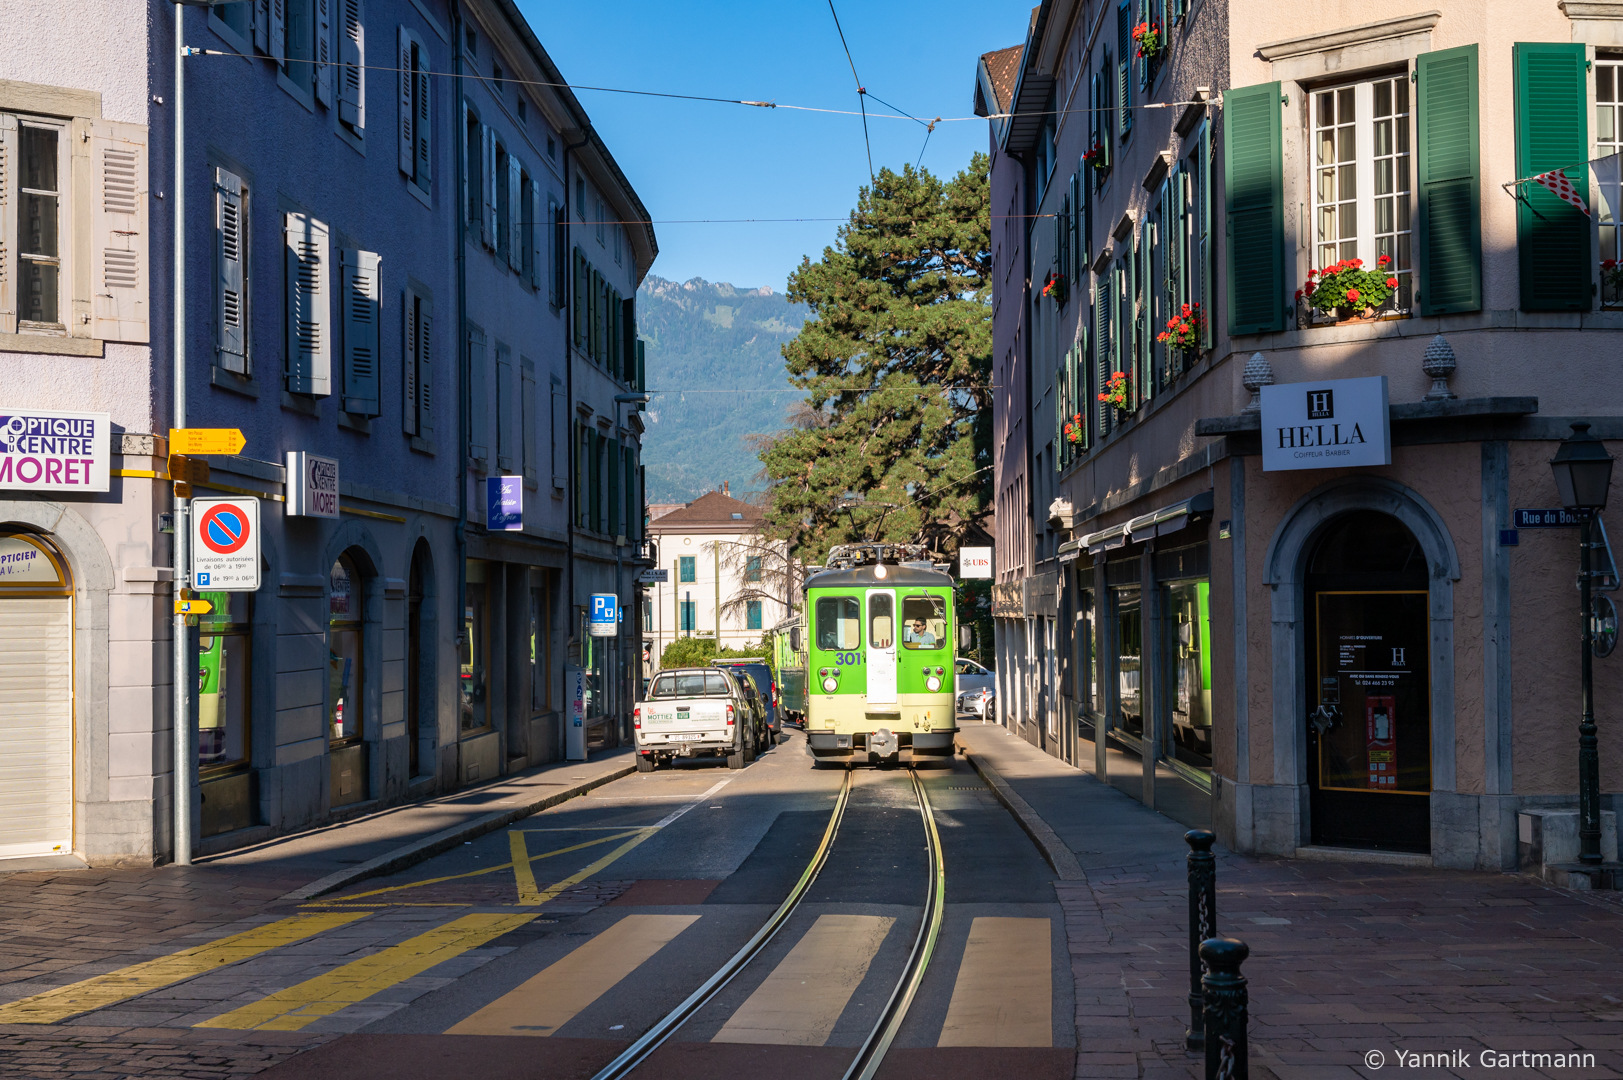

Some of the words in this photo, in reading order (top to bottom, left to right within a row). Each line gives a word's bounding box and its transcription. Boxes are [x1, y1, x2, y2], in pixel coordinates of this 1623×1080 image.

[7, 416, 93, 437] OPTIQUE
[1277, 422, 1367, 449] HELLA
[16, 434, 93, 455] CENTRE
[312, 491, 336, 514] MORET
[1522, 511, 1541, 524] Rue
[1544, 511, 1556, 524] du
[0, 550, 37, 564] PTICIEN
[835, 652, 861, 666] 301
